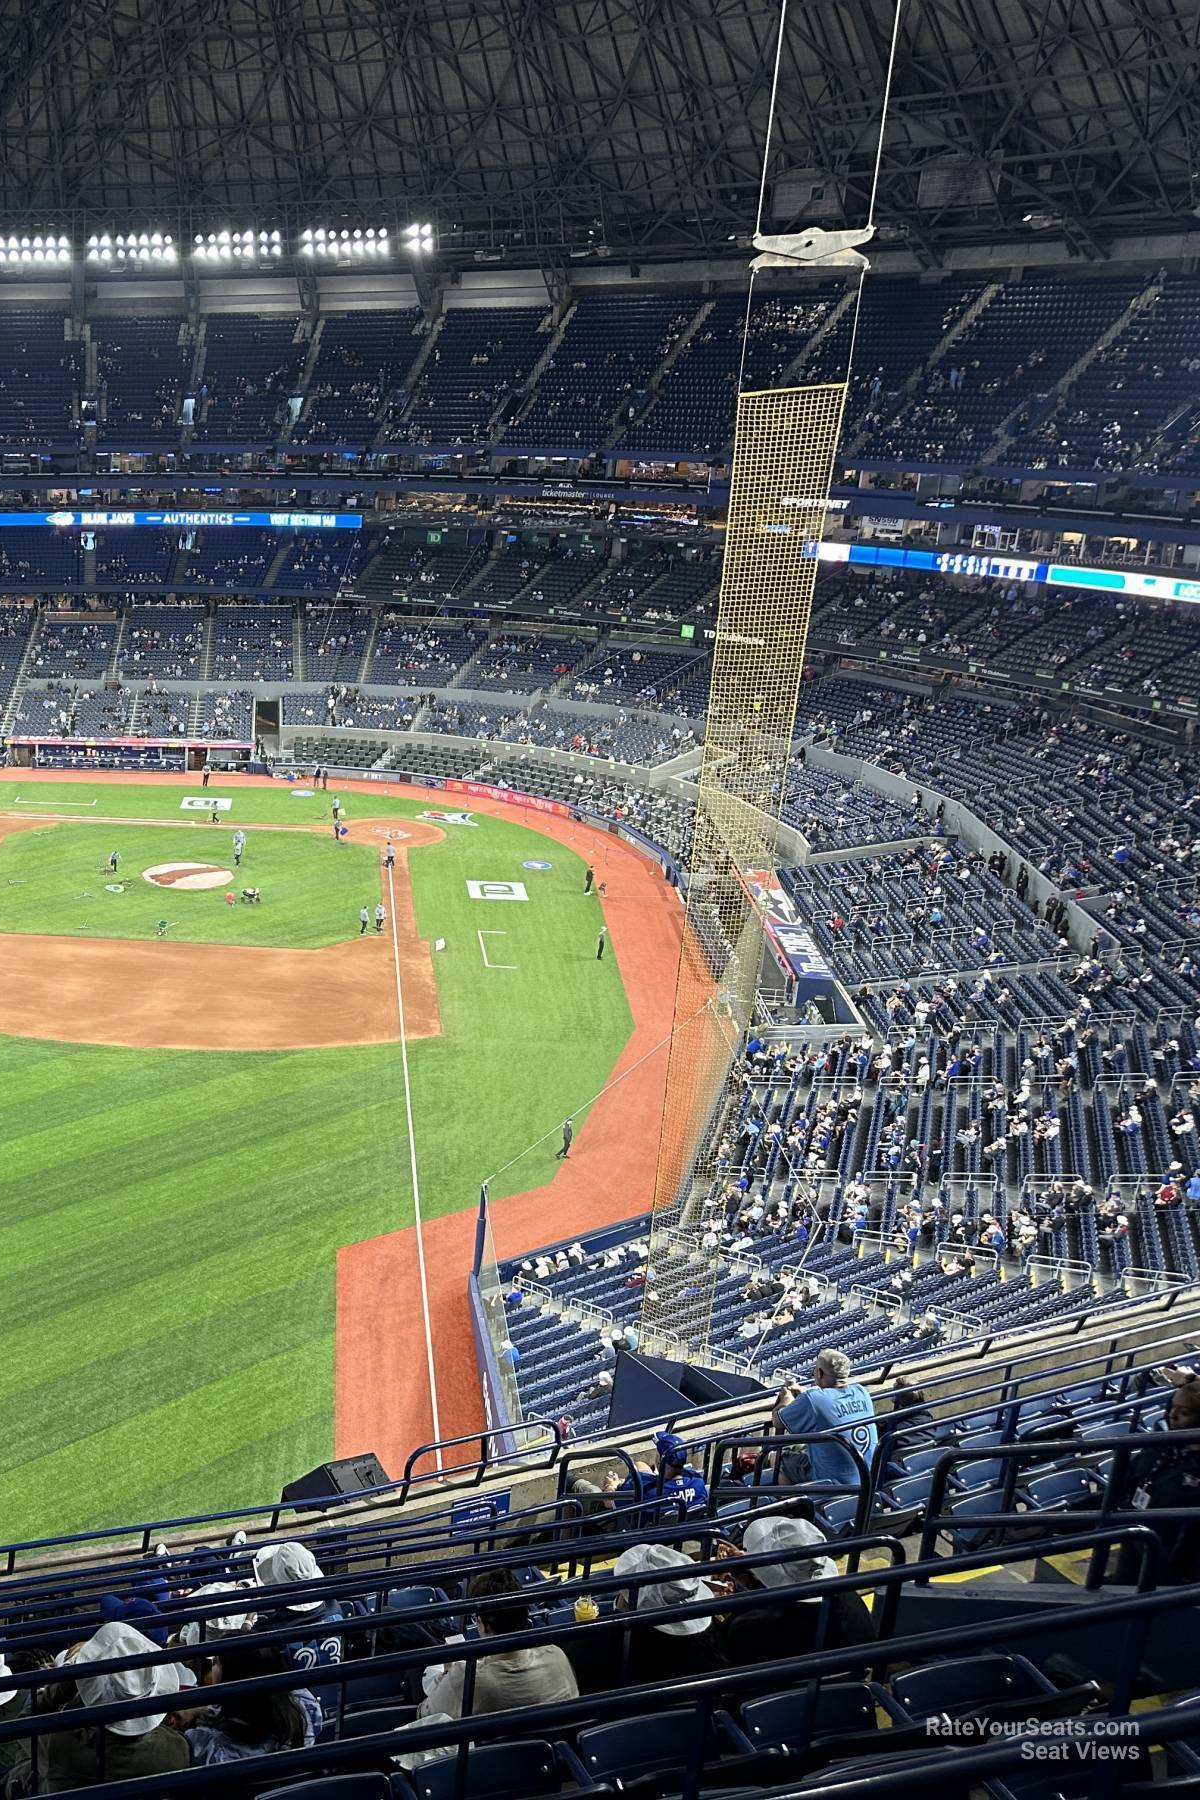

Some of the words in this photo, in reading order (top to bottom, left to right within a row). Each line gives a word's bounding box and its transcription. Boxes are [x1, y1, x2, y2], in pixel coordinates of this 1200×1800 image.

[542, 489, 585, 498] ticketmaster
[782, 498, 850, 510] SPORTSNET
[81, 513, 107, 524] BLUE
[109, 513, 135, 524] JAYS
[163, 513, 233, 525] AUTHENTICS
[270, 513, 289, 526] VISIT
[290, 514, 321, 527] SECTION
[704, 629, 716, 639] TD
[836, 1400, 868, 1418] JANSEN
[851, 1425, 871, 1457] 9
